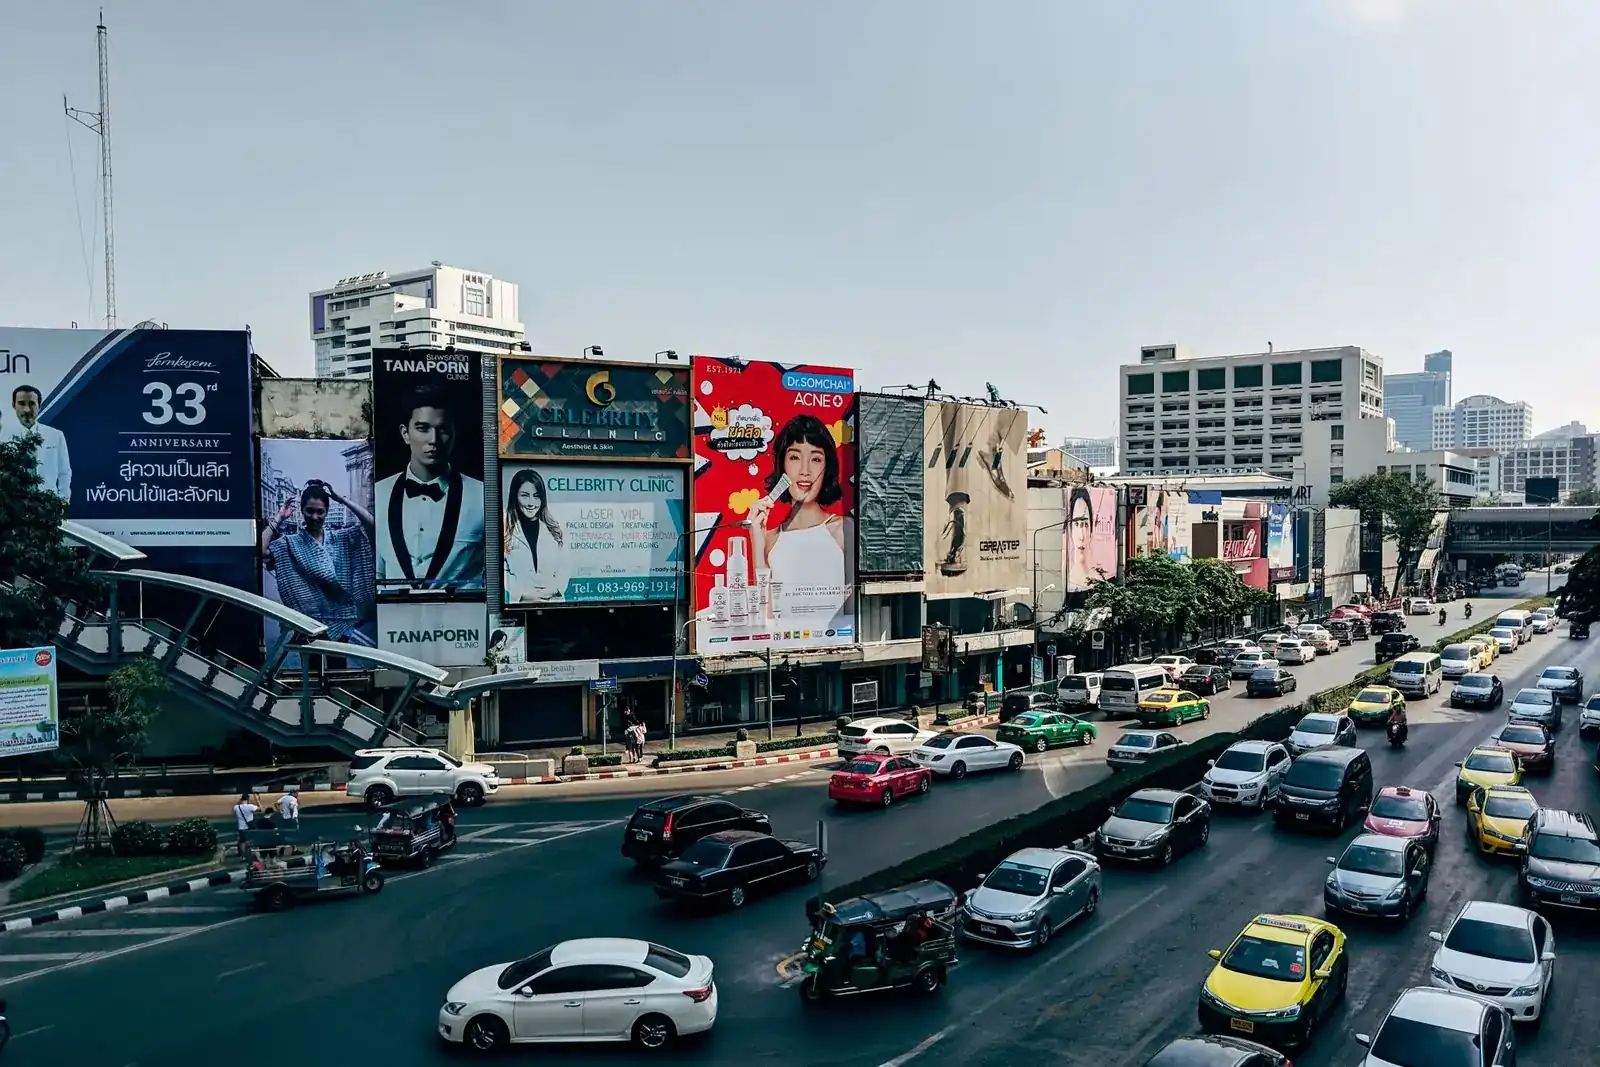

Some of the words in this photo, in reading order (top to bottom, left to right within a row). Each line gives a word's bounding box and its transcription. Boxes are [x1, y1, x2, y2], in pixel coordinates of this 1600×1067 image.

[383, 359, 470, 374] TANAPORN
[794, 392, 831, 408] ACNE
[536, 406, 658, 427] CELEBRITY
[130, 438, 221, 448] ANNIVERSARY
[562, 442, 591, 450] Aesthetic
[119, 458, 229, 482] สู่ความเป็นเลิศ
[547, 476, 625, 492] CELEBRITY
[630, 478, 675, 493] CLINIC
[87, 482, 230, 503] เพื่อคนไข้และสังคม
[580, 508, 613, 520] LASER
[566, 521, 588, 529] FACIAL
[590, 521, 613, 529] DESIGN
[570, 542, 614, 550] LIPOSUCTION
[572, 583, 593, 594] Tel.
[597, 580, 676, 593] 083-969-1914
[387, 629, 479, 643] TANAPORN
[455, 641, 479, 649] CLINIC
